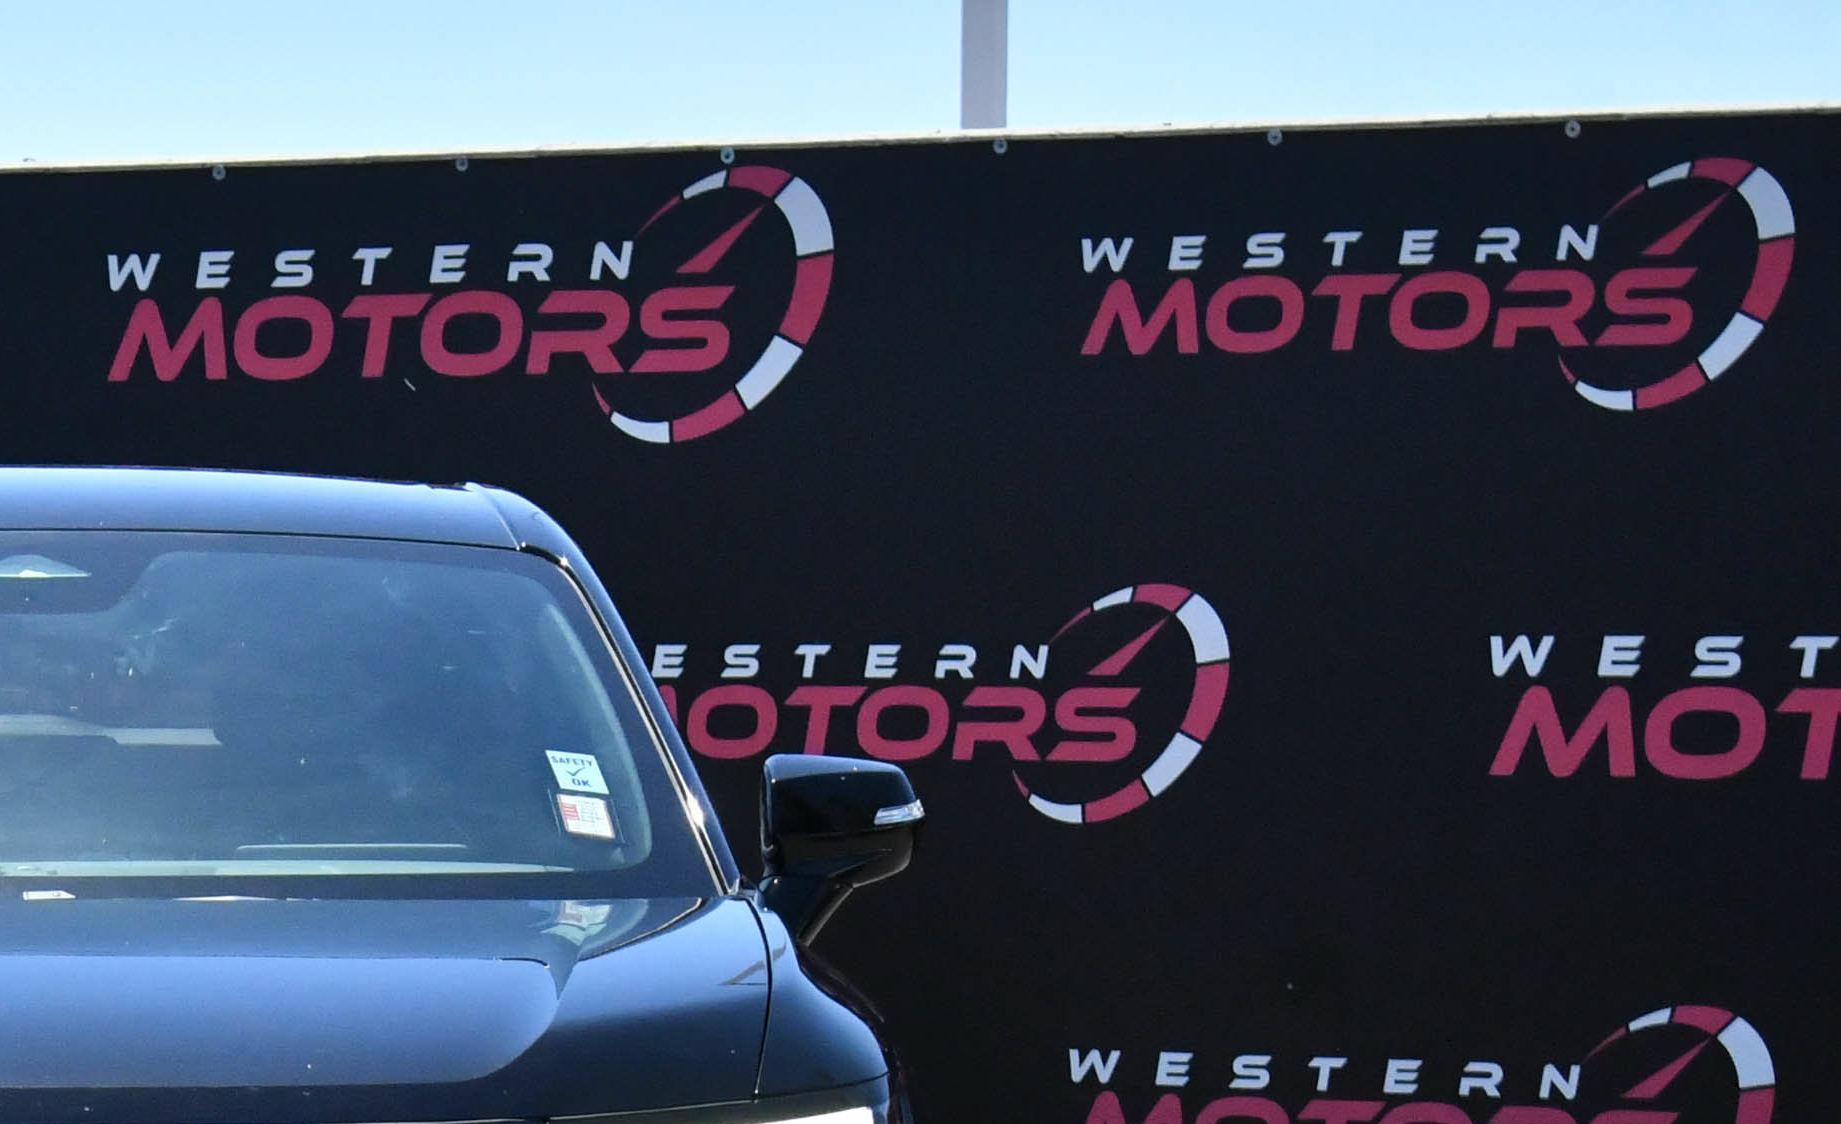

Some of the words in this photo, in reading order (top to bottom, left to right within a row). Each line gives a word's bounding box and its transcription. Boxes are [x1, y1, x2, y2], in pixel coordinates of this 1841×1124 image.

[108, 241, 632, 291] WESTERN
[1082, 225, 1597, 272] WESTERN
[109, 286, 734, 381] MOTORS
[1083, 268, 1695, 355] MOTORS
[650, 645, 1048, 684] ESTERN
[1491, 636, 1838, 677] WEST
[660, 685, 1139, 762] OTORS
[550, 756, 593, 767] SAFETY
[1070, 1049, 1580, 1099] WESTERN
